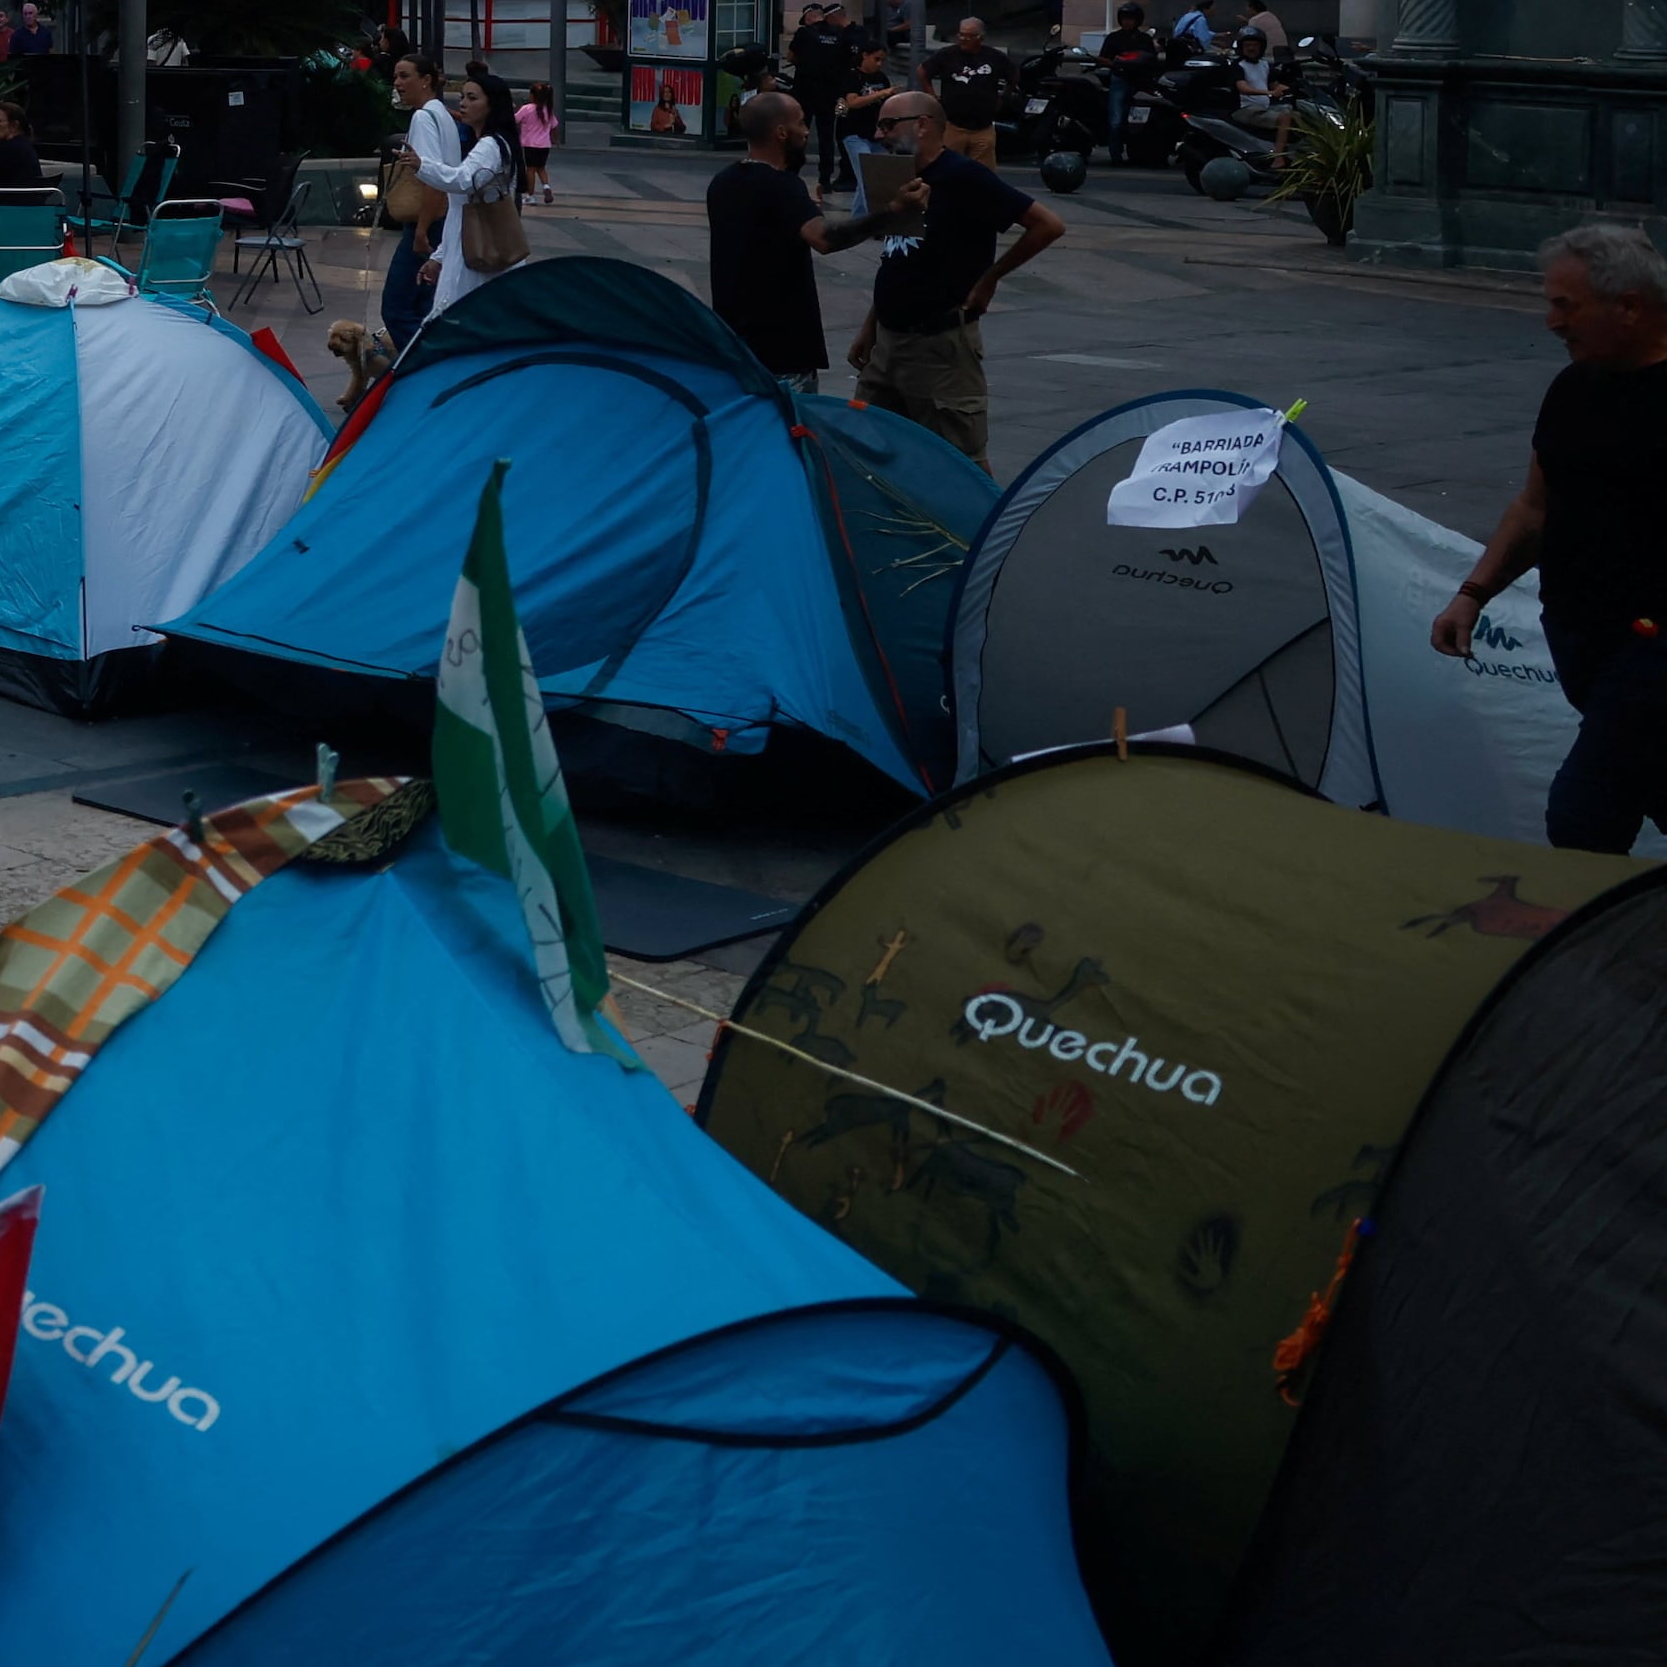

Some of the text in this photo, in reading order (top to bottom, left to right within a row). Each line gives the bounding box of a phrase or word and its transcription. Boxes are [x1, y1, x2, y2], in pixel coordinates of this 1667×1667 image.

[1153, 487, 1188, 503] C.P.
[965, 991, 1225, 1107] Quechua
[21, 1289, 221, 1433] echua
